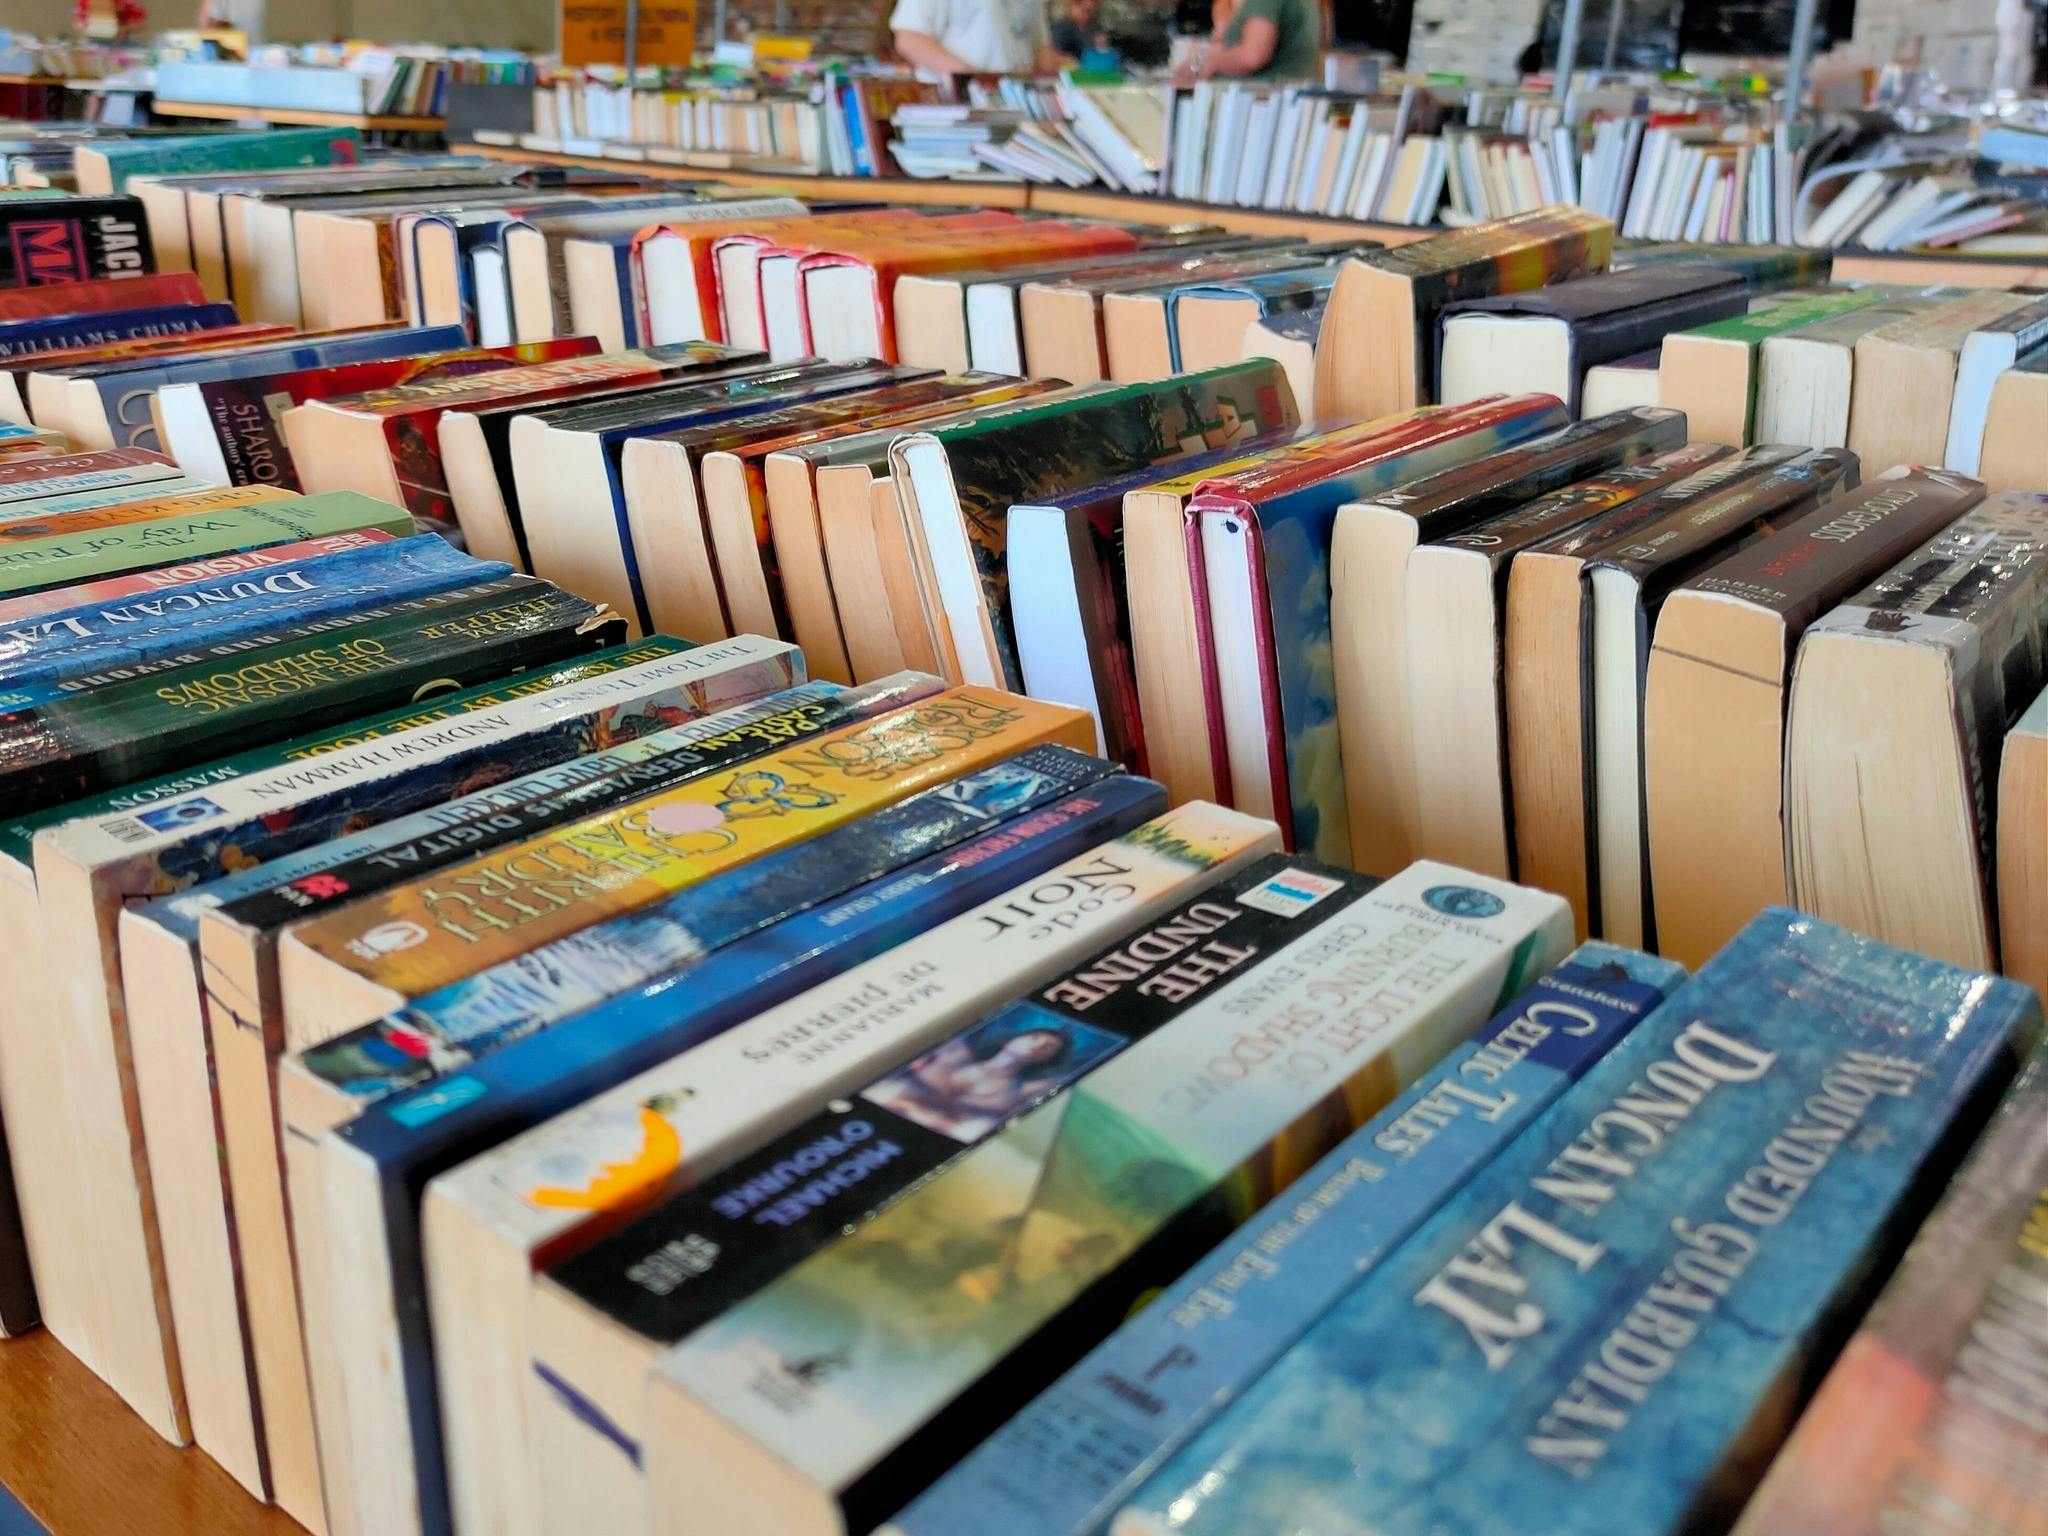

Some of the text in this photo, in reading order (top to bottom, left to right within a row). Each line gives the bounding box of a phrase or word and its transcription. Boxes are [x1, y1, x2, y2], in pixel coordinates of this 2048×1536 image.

[127, 318, 204, 341] CHIMA
[231, 403, 284, 487] SHARO
[172, 490, 261, 512] GREG
[1808, 508, 1882, 545] GHOSTS
[84, 535, 125, 553] of
[127, 534, 195, 553] The
[142, 520, 237, 543] Way
[99, 569, 321, 627] DUNCAN
[139, 550, 283, 588] VISION
[209, 635, 282, 657] AND
[414, 598, 558, 641] HARPER
[58, 652, 204, 692] BEYOND
[155, 638, 386, 707] OF SHADOWS
[183, 650, 409, 717] THE MOSAIC
[620, 645, 675, 670] THE
[632, 652, 705, 688] TOME
[704, 644, 759, 667] THE
[384, 705, 456, 738] THE
[456, 690, 504, 717] BY
[750, 717, 823, 744] PAT
[243, 712, 512, 803] ANDREW HARMAN
[283, 724, 384, 763] POOL
[107, 766, 240, 813] MASSON
[365, 814, 522, 871] DIGITAL
[414, 807, 675, 918] BALDRY
[433, 826, 740, 945] CHERITH
[1026, 882, 1137, 945] Code
[1039, 894, 1243, 1017] UNDINE
[1132, 935, 1258, 1008] THE
[1293, 920, 1368, 979] CHRIS
[1305, 920, 1442, 1010] BURNING
[1403, 949, 1468, 997] THE
[740, 958, 942, 1066] DE PIERRES
[1216, 963, 1293, 1020] EVANS
[1328, 983, 1411, 1056] LIGHT
[793, 981, 947, 1072] MARIANNE
[1158, 998, 1326, 1119] SHADOWS
[1370, 1000, 1600, 1160] CELTIC TALES
[1529, 1017, 1779, 1215] DUNCAN
[708, 1116, 874, 1223] O'ROURKE
[748, 1132, 905, 1230] MICHAEL
[1411, 1201, 1606, 1372] LAY
[1522, 1048, 1925, 1482] WOUNDED GUARDIAN
